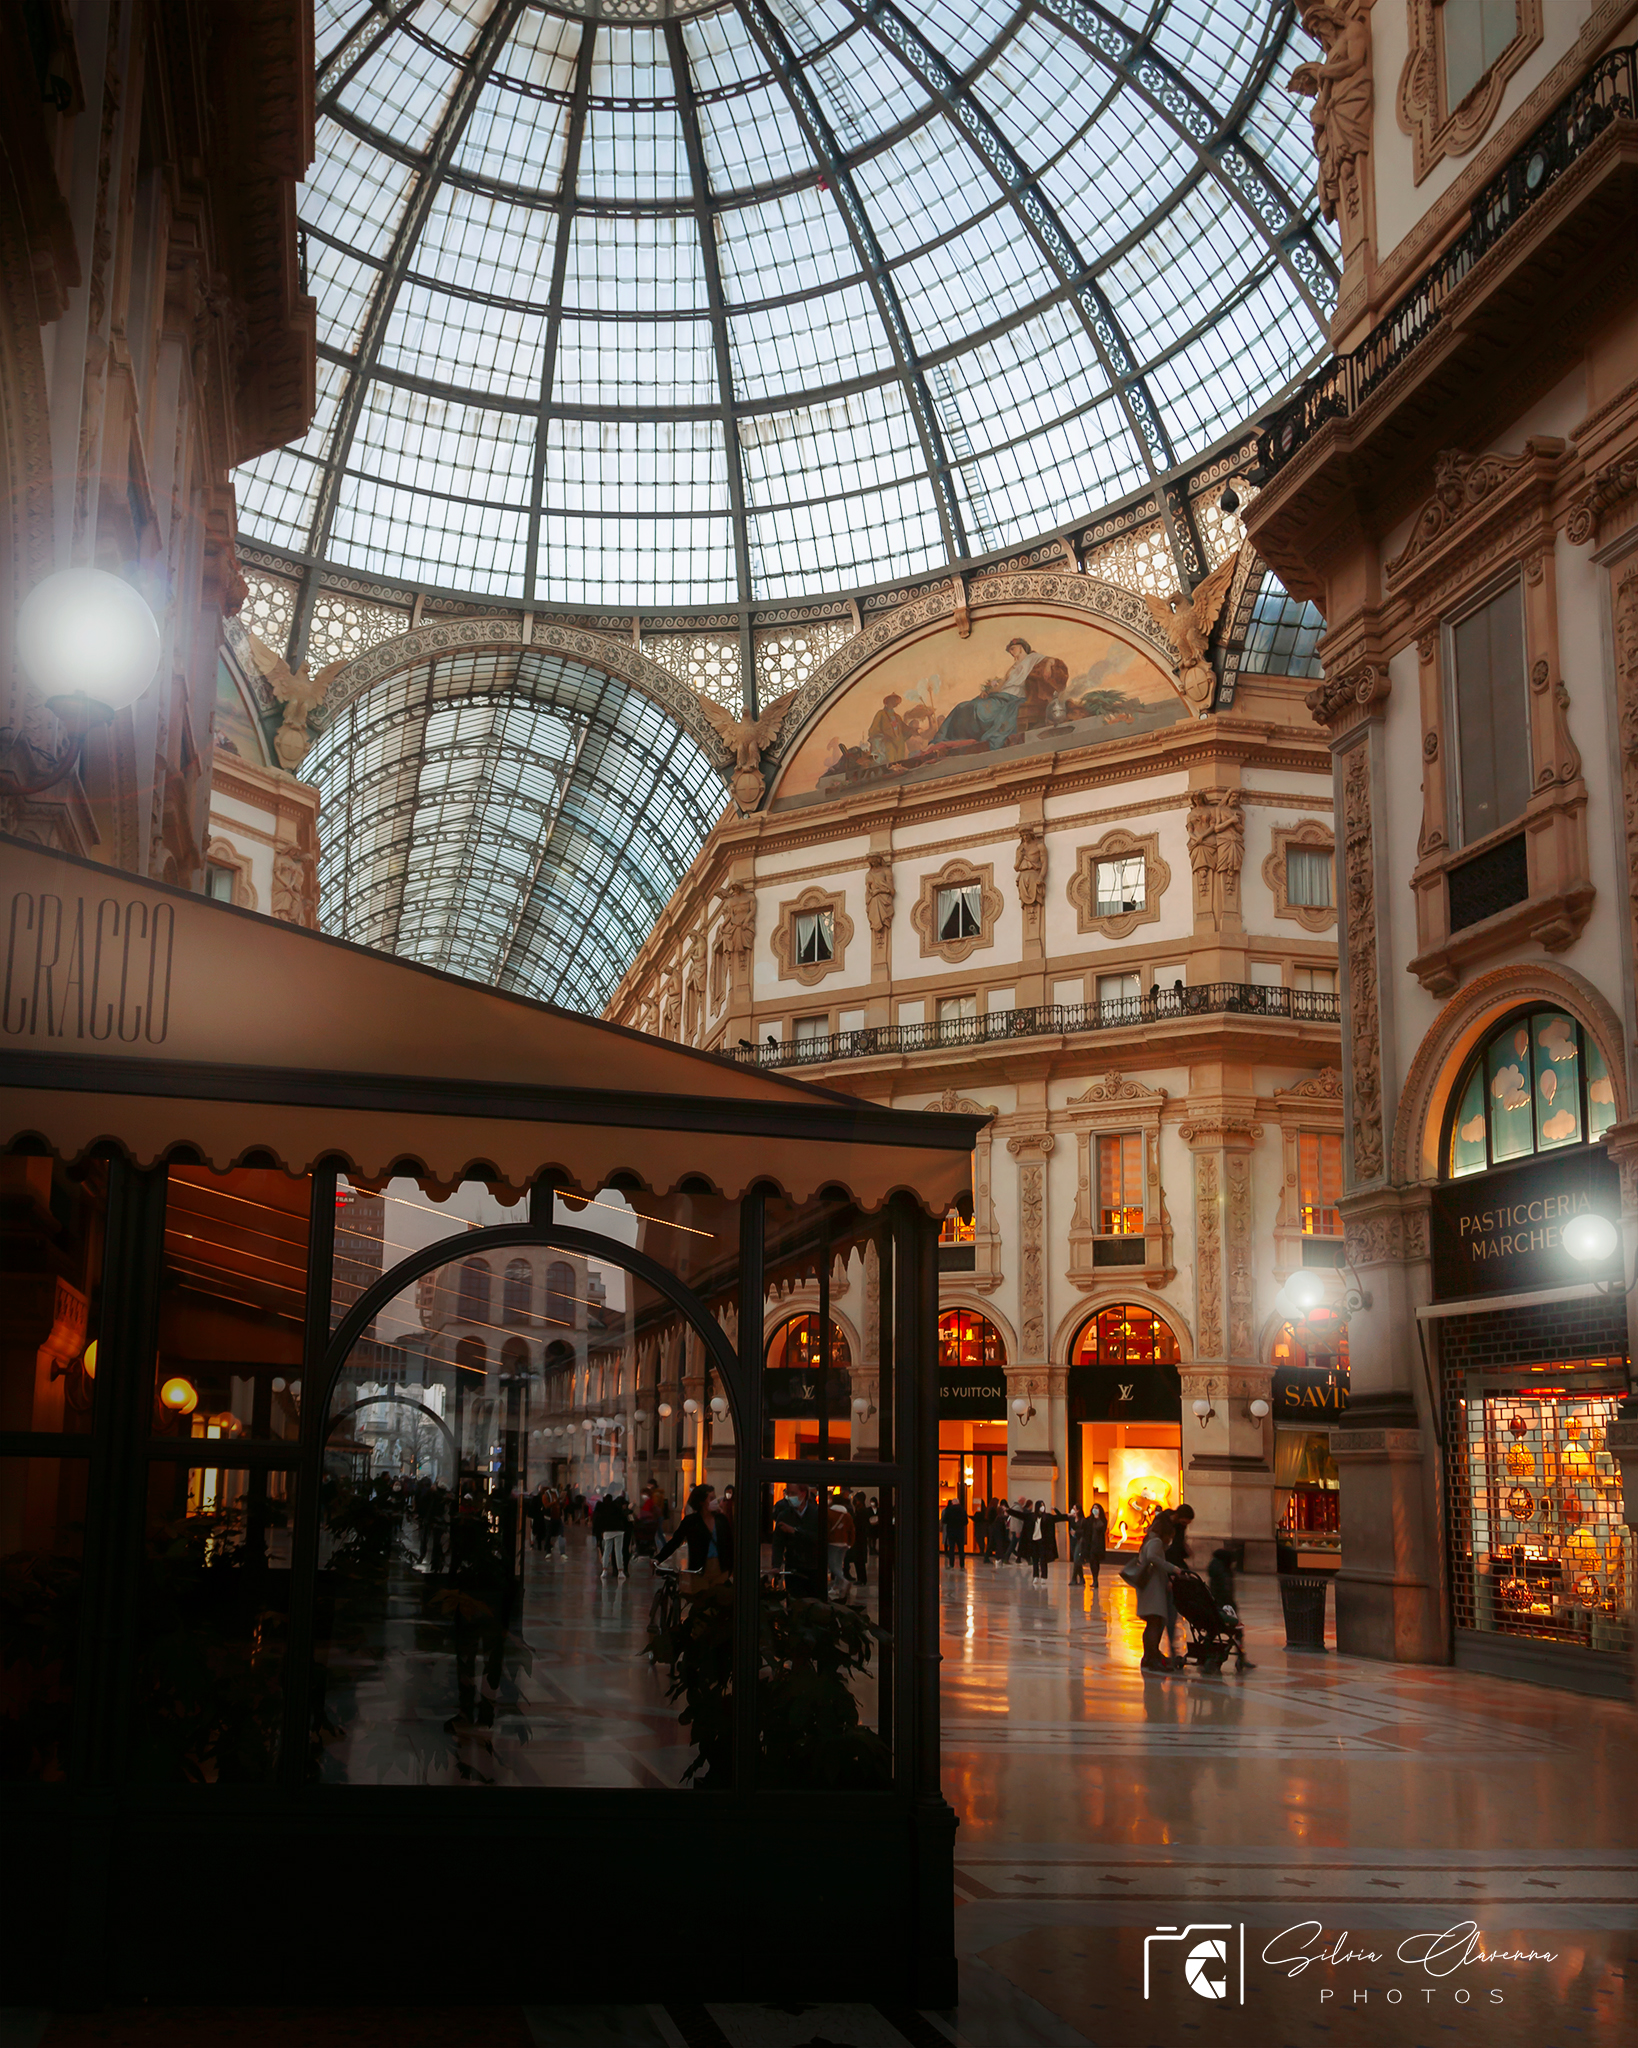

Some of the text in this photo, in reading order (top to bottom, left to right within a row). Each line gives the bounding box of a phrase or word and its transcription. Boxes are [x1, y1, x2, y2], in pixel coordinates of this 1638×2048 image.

[2, 892, 175, 1045] CRACCO
[1460, 1190, 1592, 1237] PASTICCERIA
[952, 1387, 1001, 1398] VUITTON
